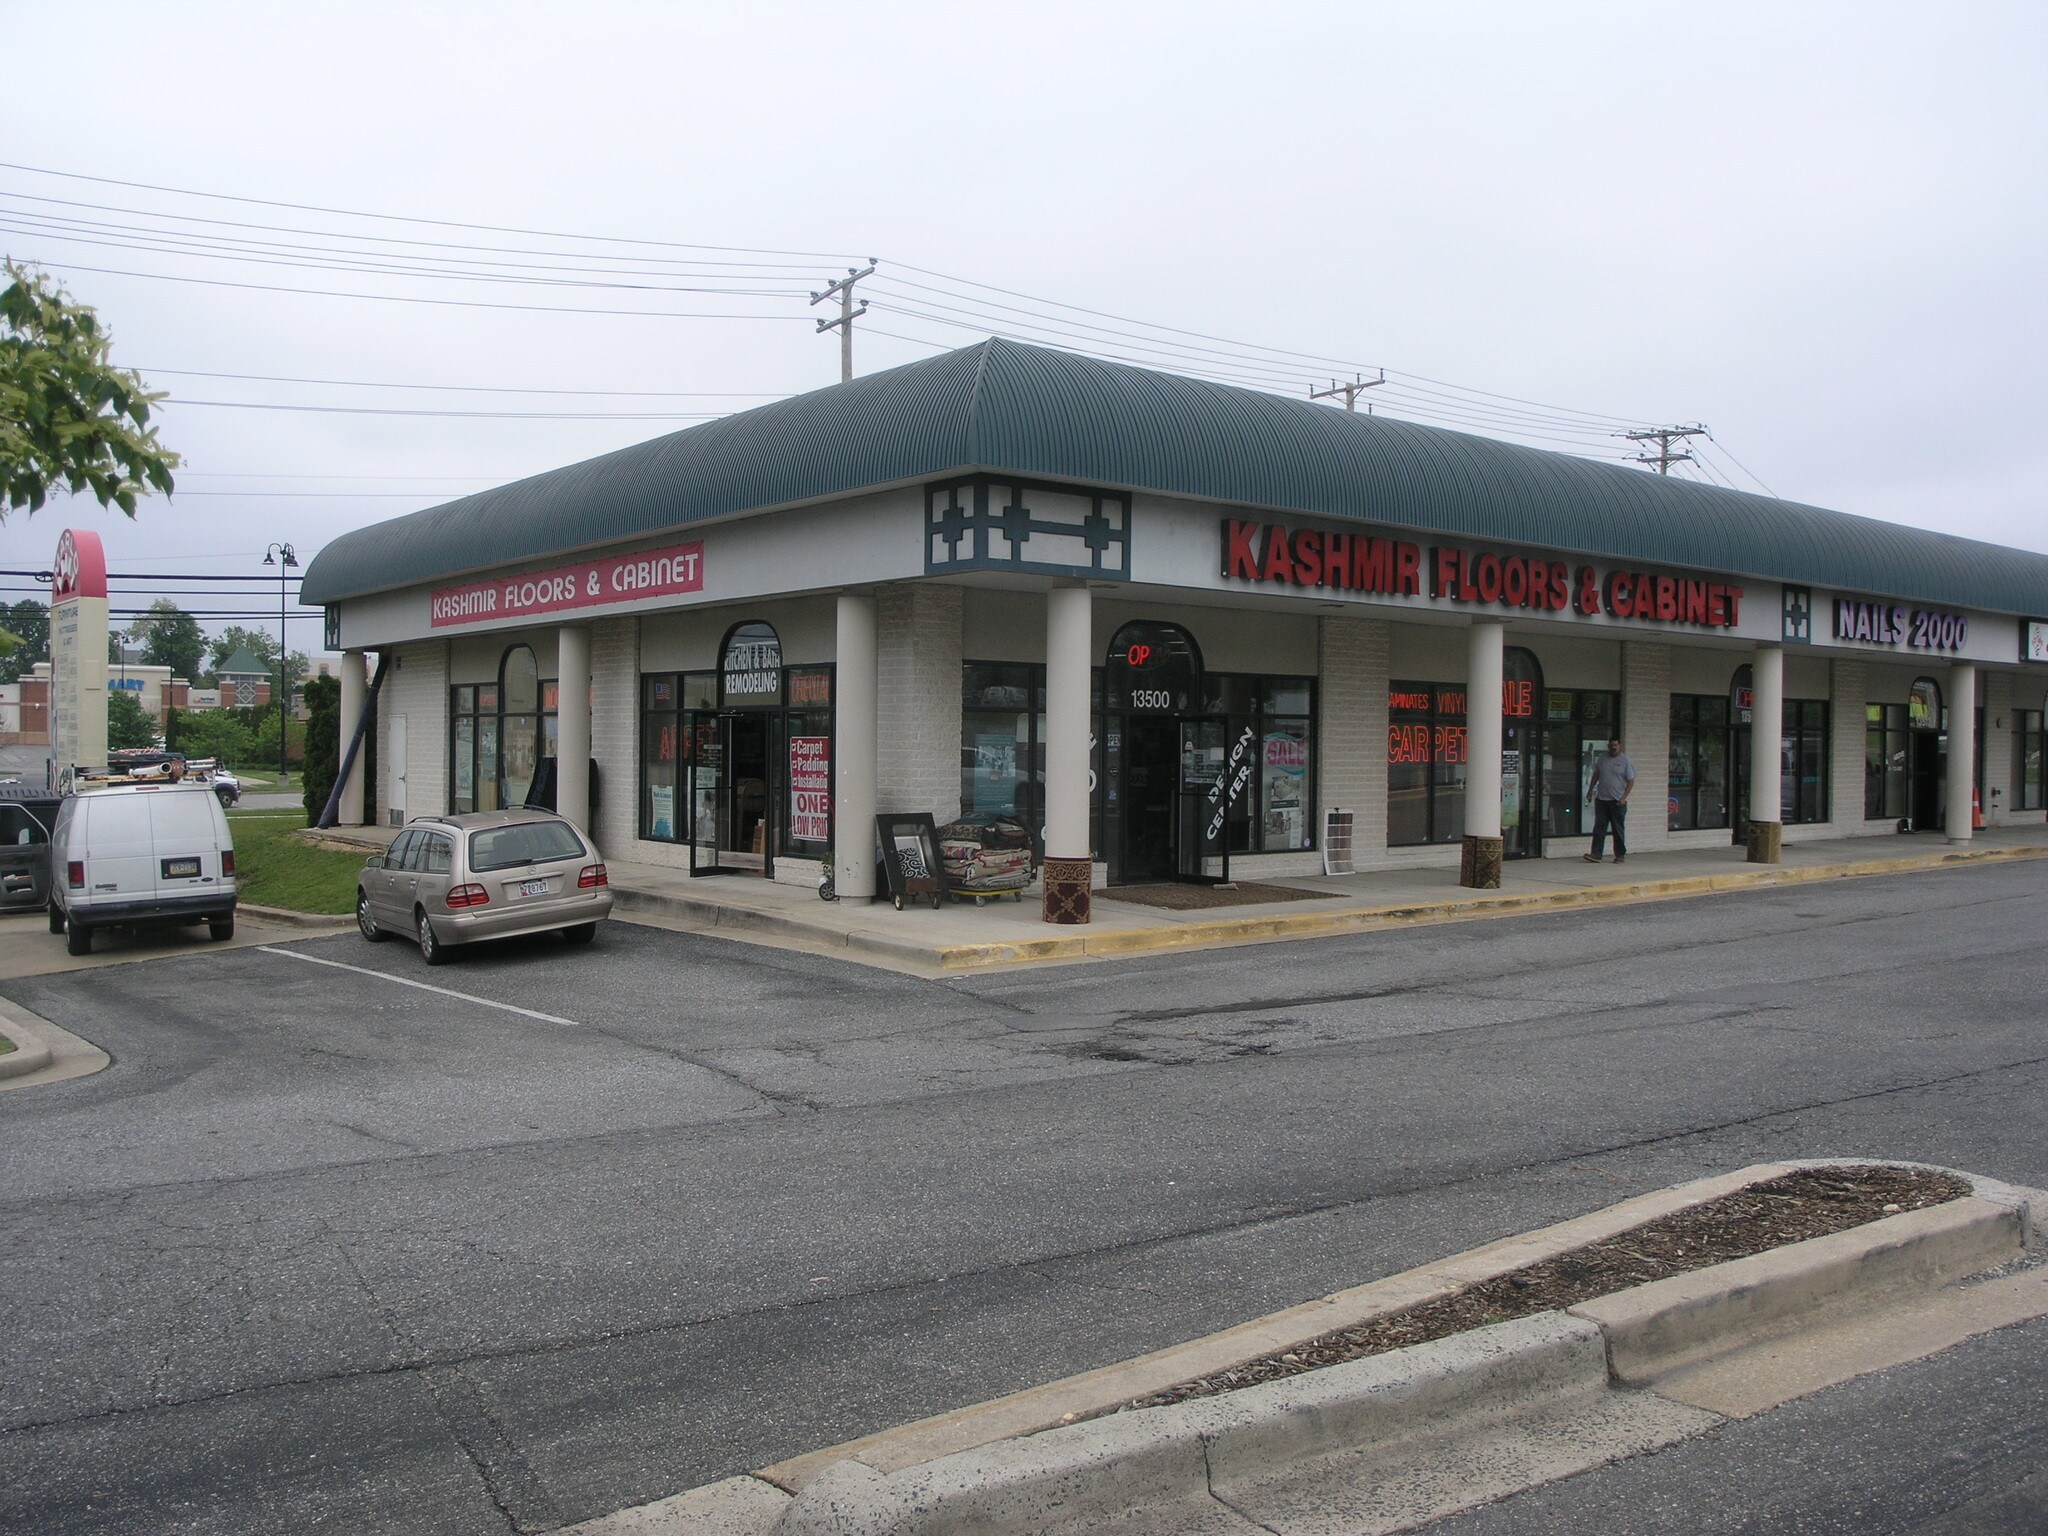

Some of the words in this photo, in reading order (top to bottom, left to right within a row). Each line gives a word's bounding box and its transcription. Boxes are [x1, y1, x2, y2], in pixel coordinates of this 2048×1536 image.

[1222, 519, 1420, 596] KASHMIR
[1430, 547, 1569, 611] FLOORS
[1574, 565, 1600, 615] &
[1604, 569, 1744, 627] CABINET
[433, 588, 496, 619] KASHMIR
[505, 574, 576, 609] FLOORS
[587, 570, 600, 596] &
[612, 553, 698, 592] CABINET
[1834, 599, 1906, 645] NAILS
[1911, 610, 1969, 651] 2000
[724, 644, 751, 671] KITCHEN
[753, 643, 761, 669] &
[762, 645, 780, 669] BATH
[726, 671, 777, 694] REMODELING
[1131, 690, 1170, 708] 13500
[1388, 692, 1429, 709] AMINATES
[1501, 681, 1532, 716] ALE
[796, 740, 823, 757] Carpet
[1267, 739, 1307, 766] SALE
[1387, 725, 1469, 764] CARPET
[797, 757, 828, 774] Padding
[798, 774, 828, 789] Installatio
[797, 793, 828, 813] ONE
[793, 815, 809, 836] LOW
[812, 816, 828, 838] PRIC
